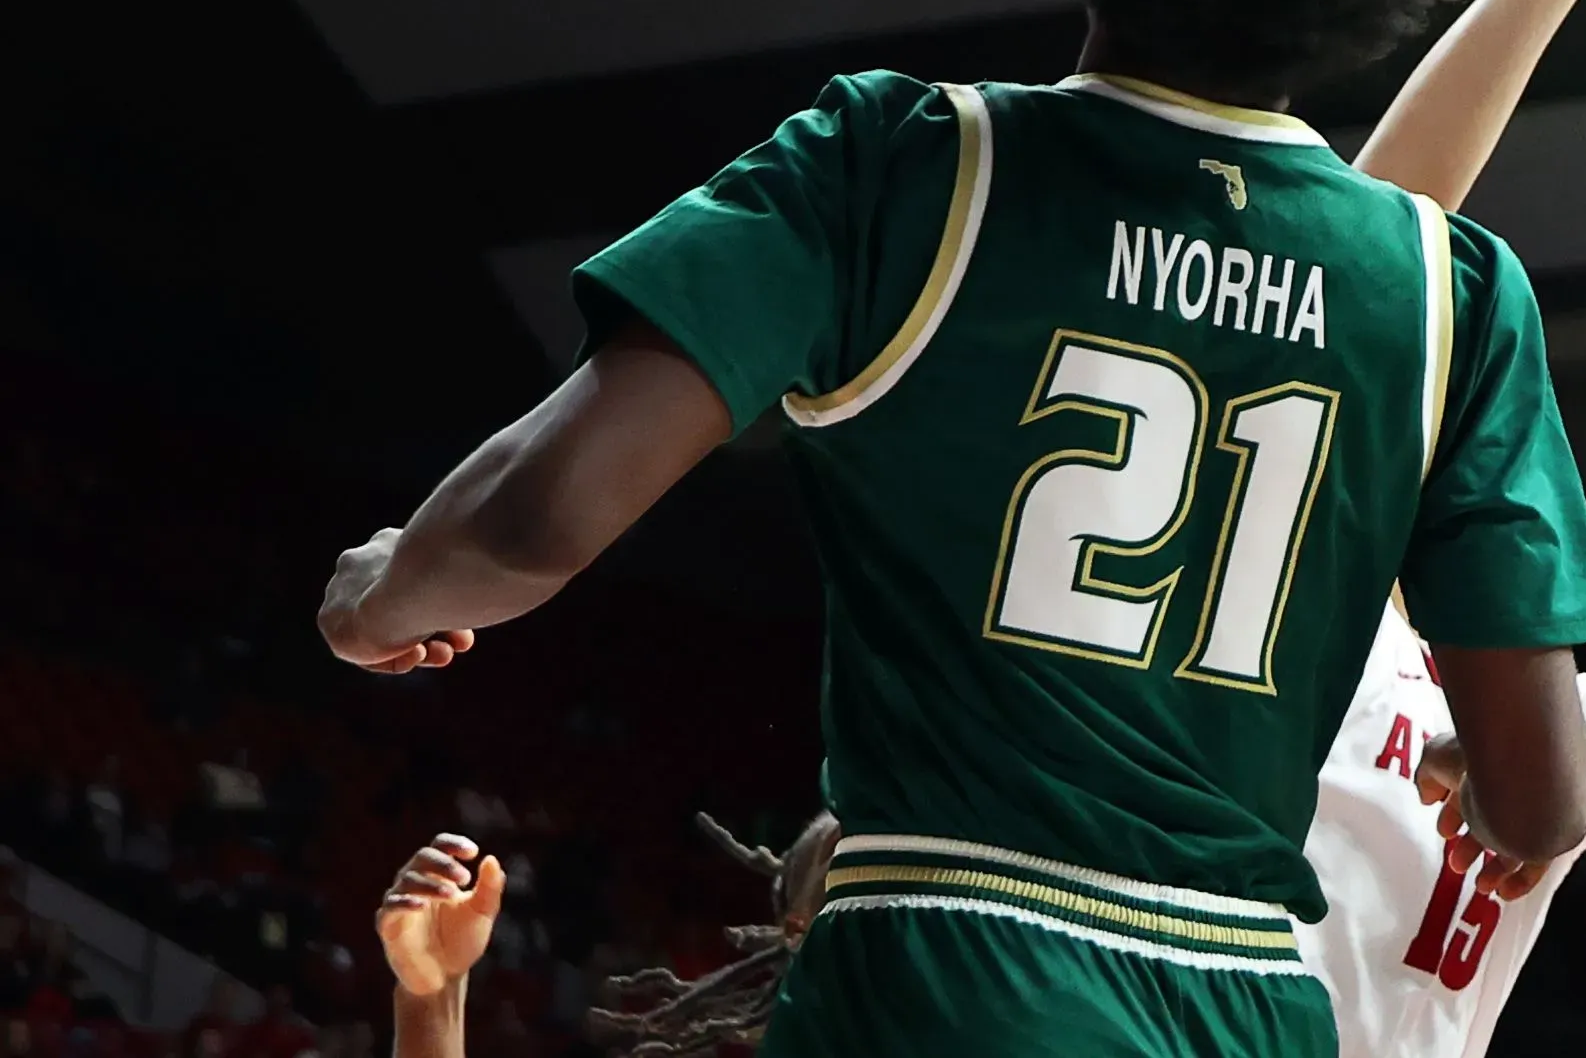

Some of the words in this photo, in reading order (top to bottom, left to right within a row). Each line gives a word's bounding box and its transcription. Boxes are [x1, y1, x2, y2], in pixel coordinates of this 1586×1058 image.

[1107, 220, 1326, 348] NYORHA
[982, 328, 1341, 696] 21
[1402, 834, 1502, 992] 15
